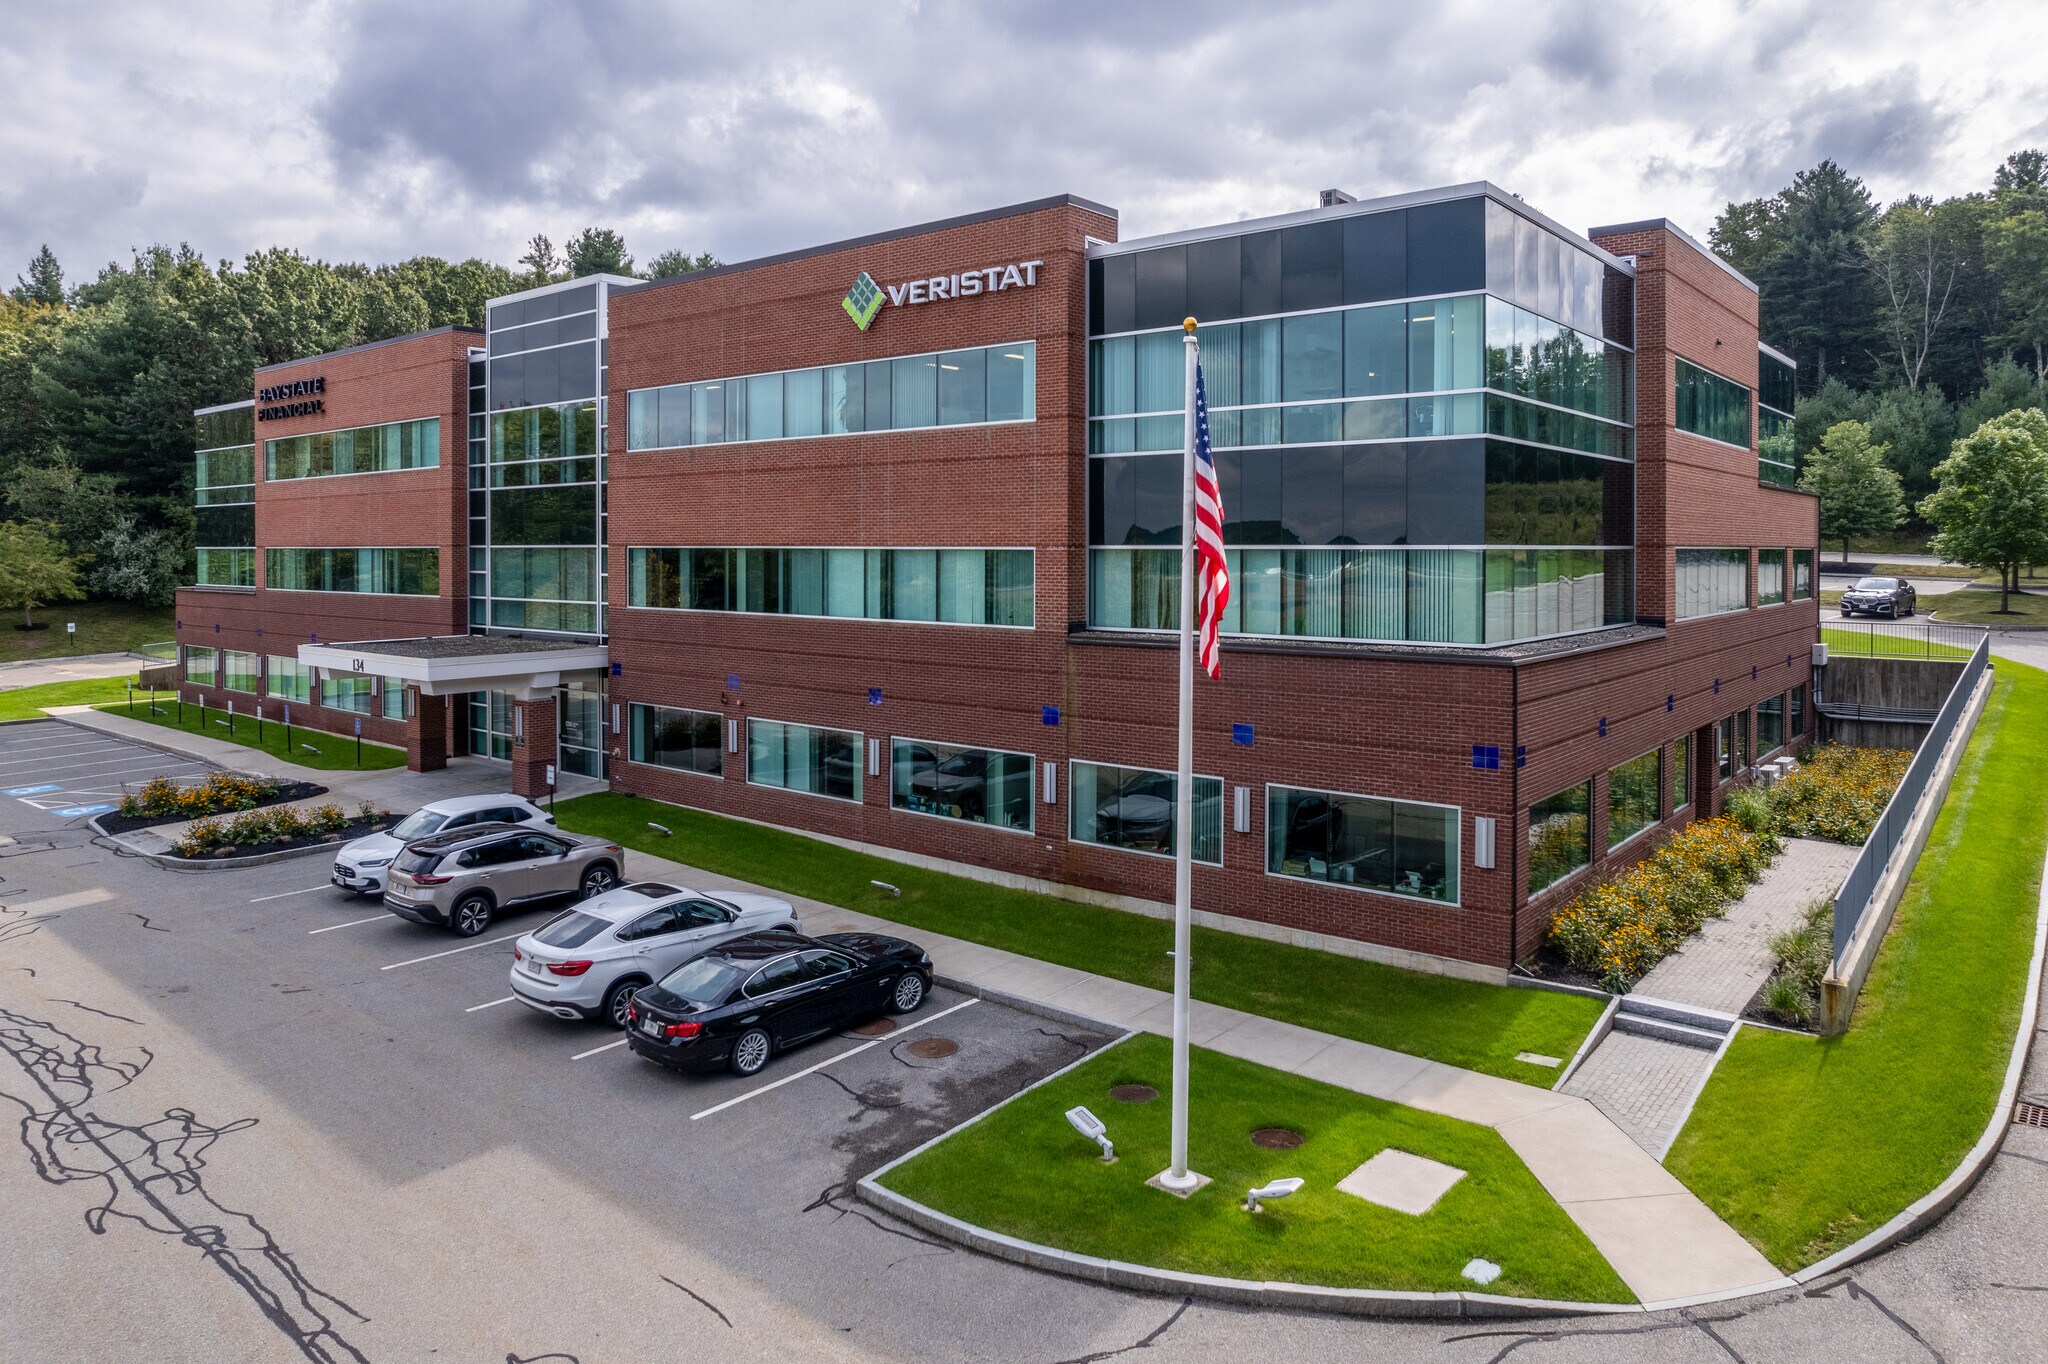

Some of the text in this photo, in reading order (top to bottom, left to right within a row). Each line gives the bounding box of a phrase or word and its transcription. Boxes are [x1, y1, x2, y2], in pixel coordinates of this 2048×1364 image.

[887, 260, 1044, 307] VERISTAT
[258, 377, 325, 403] BAYSTATE
[258, 400, 325, 421] FINANCIAL
[353, 659, 364, 672] 134
